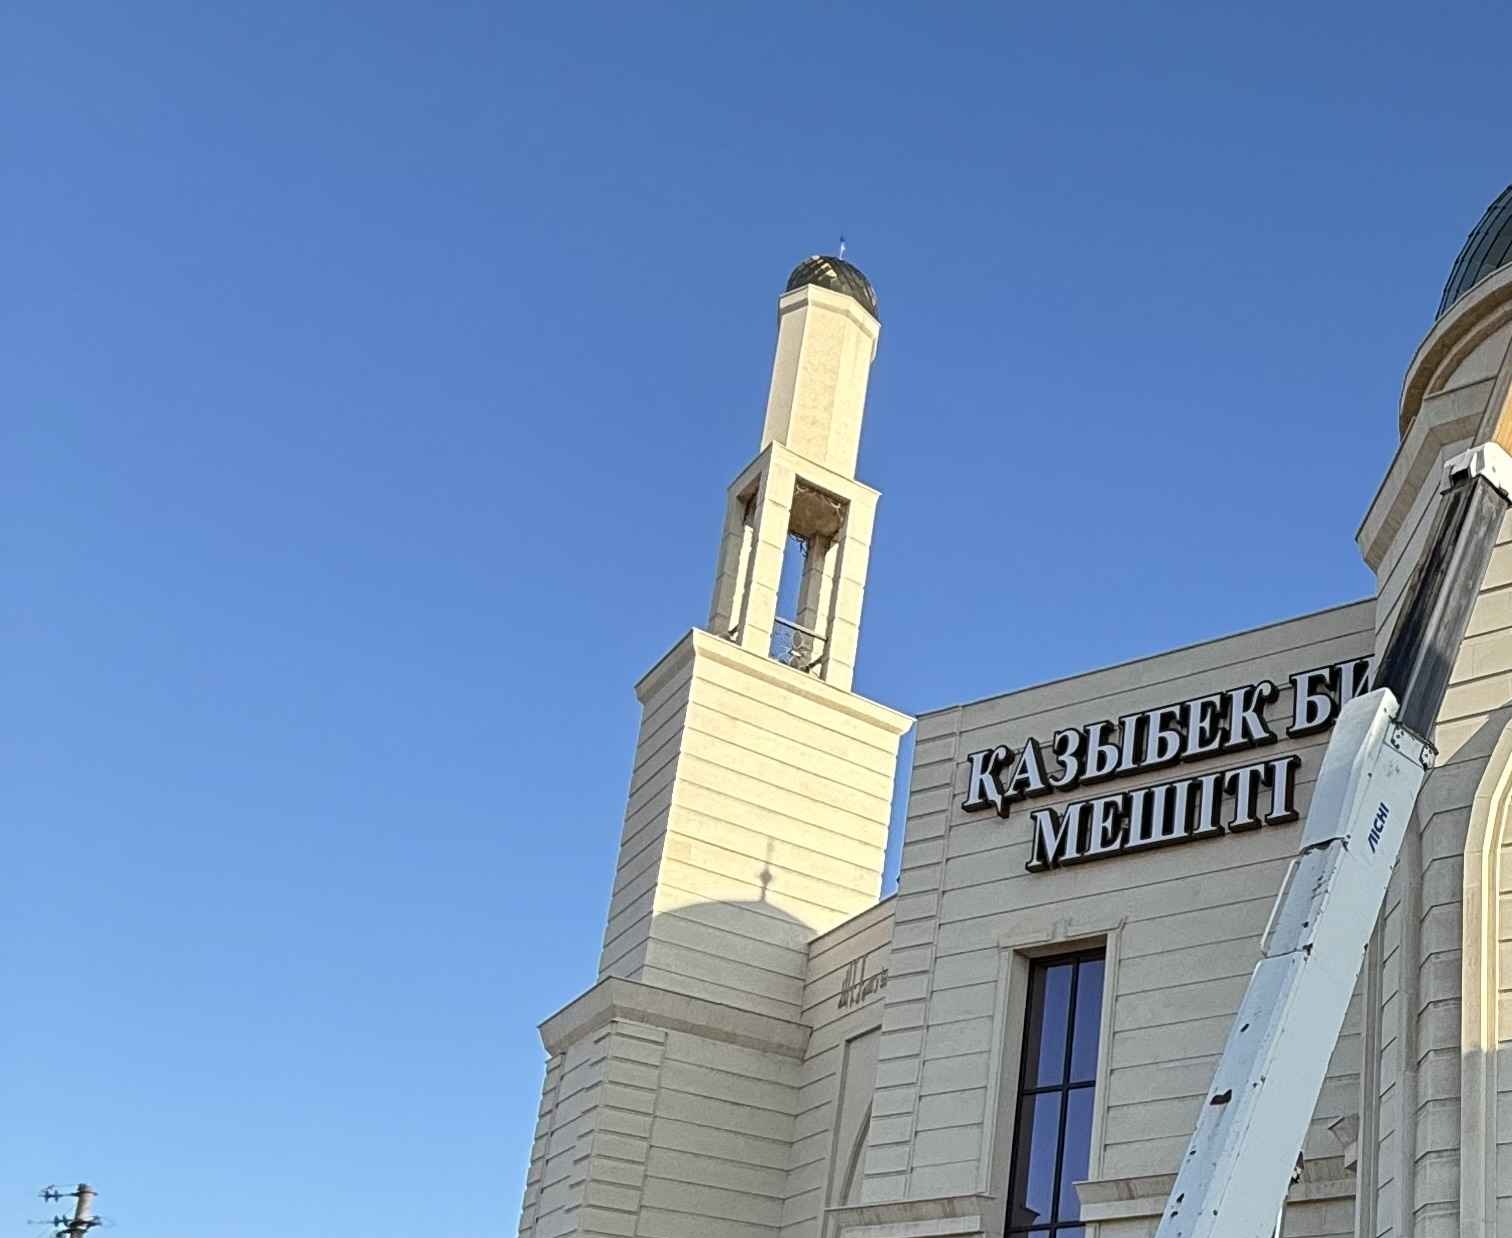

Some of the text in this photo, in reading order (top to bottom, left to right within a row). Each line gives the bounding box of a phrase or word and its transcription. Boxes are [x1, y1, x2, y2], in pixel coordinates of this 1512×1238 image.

[962, 680, 1279, 818] ҚАЗЫБЕК
[1025, 755, 1300, 873] МЕШІТІ
[1368, 801, 1389, 854] AICHI
